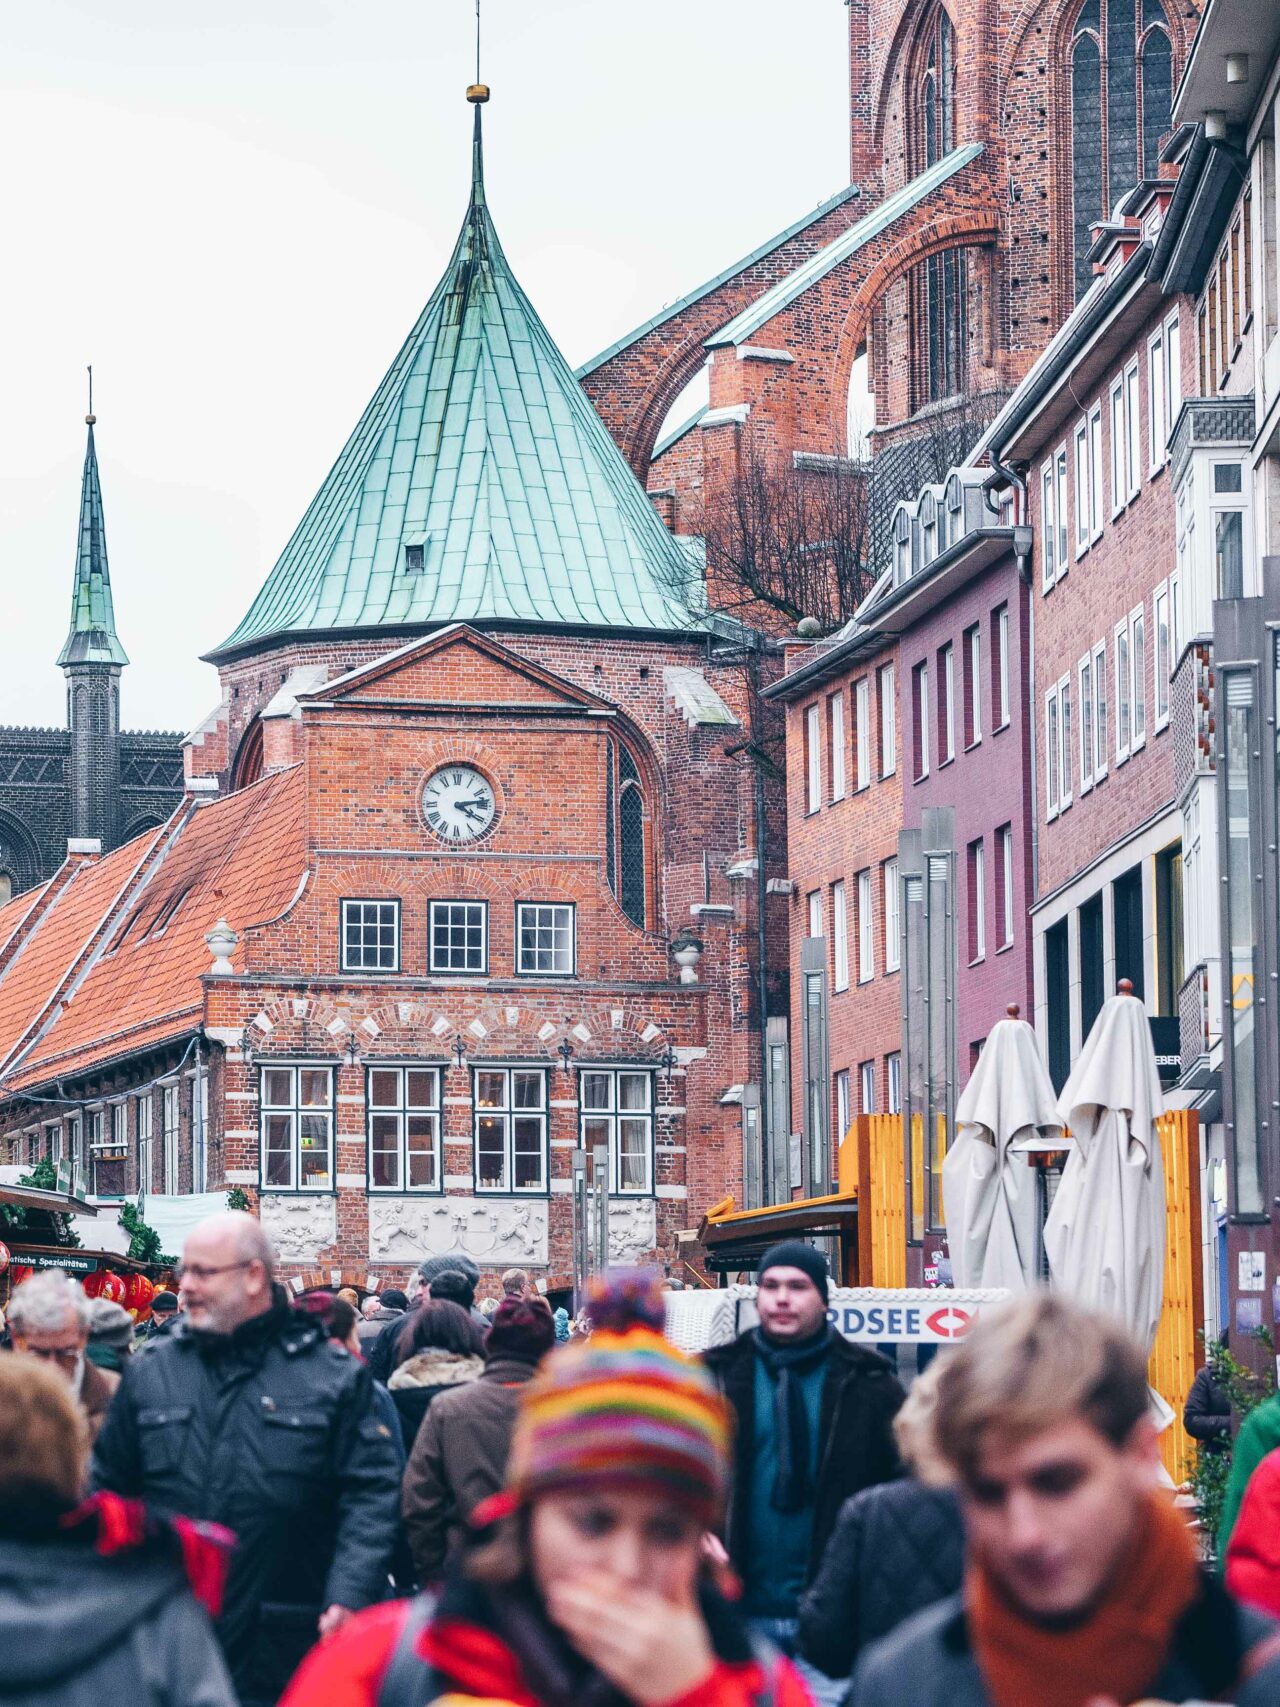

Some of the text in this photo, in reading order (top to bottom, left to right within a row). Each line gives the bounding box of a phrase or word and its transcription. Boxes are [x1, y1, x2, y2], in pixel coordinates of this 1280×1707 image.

[1155, 1055, 1181, 1066] EBER
[10, 1256, 88, 1269] atische Spezialitäten
[826, 1308, 920, 1334] RDSEE
